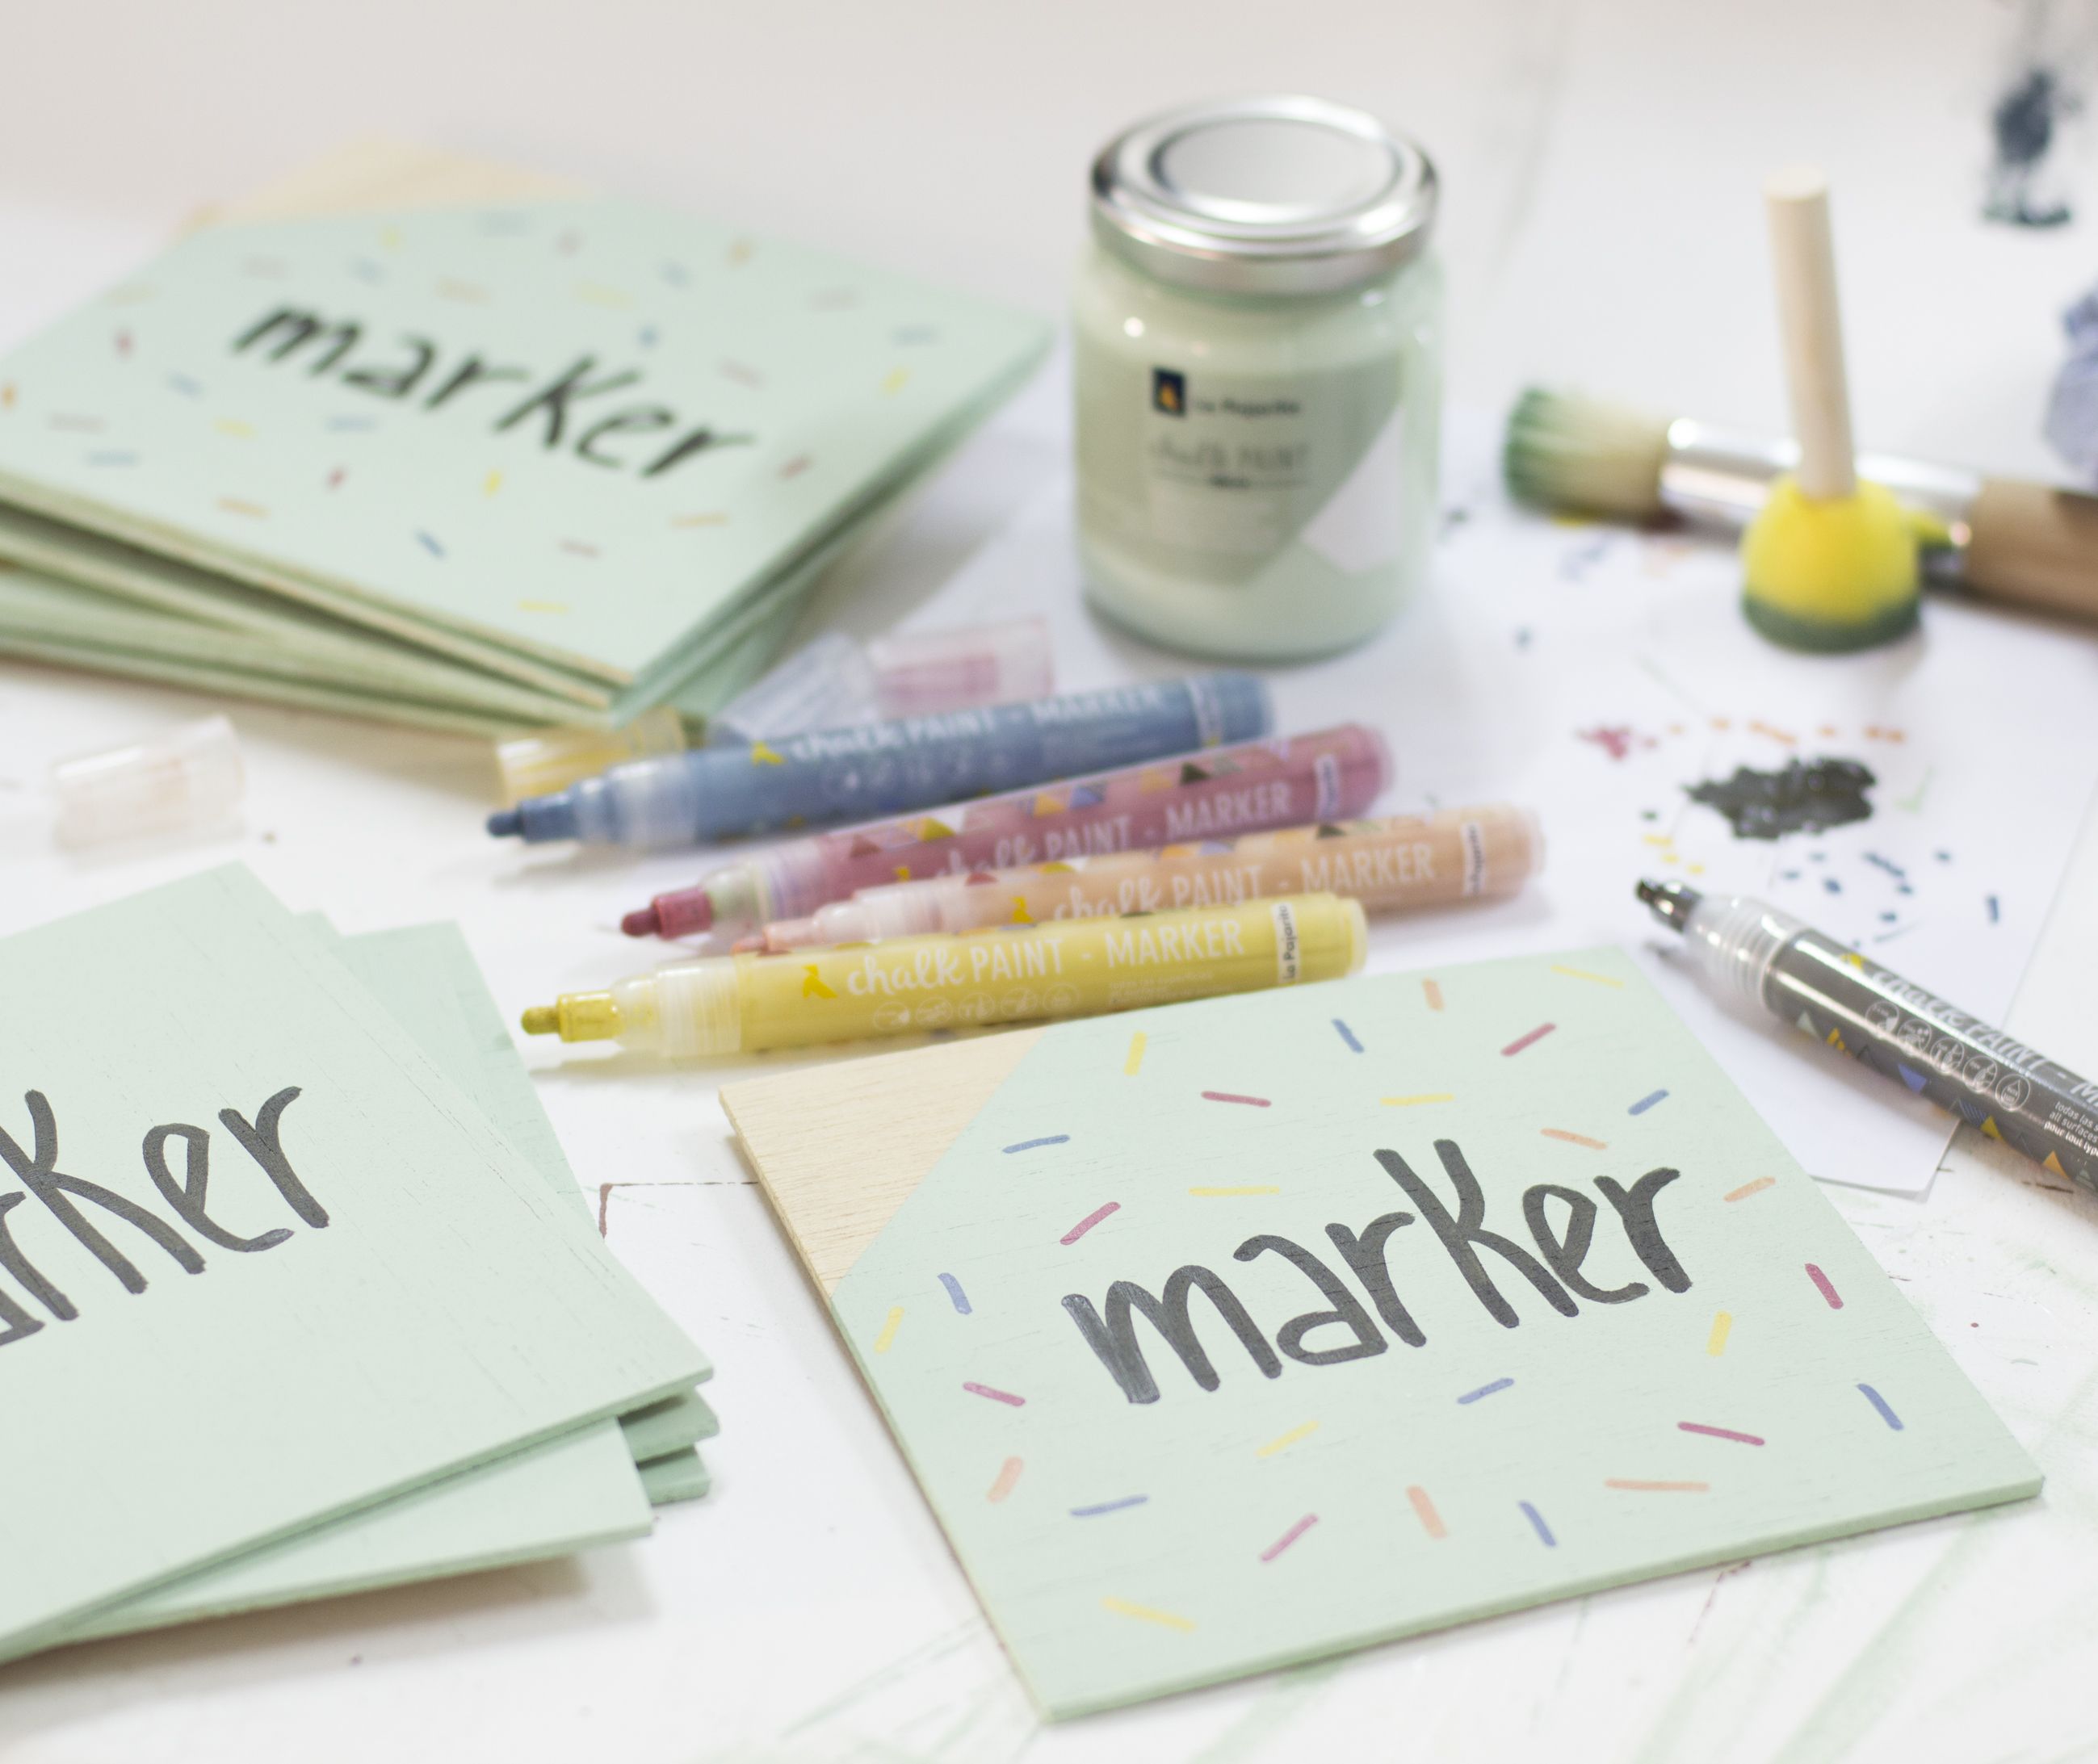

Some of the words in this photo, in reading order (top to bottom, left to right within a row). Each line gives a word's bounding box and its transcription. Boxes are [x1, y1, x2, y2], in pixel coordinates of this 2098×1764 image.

[1045, 814, 1130, 861] PAINT
[1164, 781, 1290, 838] MARKER
[1173, 865, 1263, 907] PAINT
[1301, 843, 1436, 895] MARKER
[848, 948, 966, 995] chalk
[971, 938, 1063, 983] PAINT
[1105, 919, 1244, 969] MARKER
[2054, 1100, 2079, 1120] todas
[2079, 1114, 2094, 1129] las
